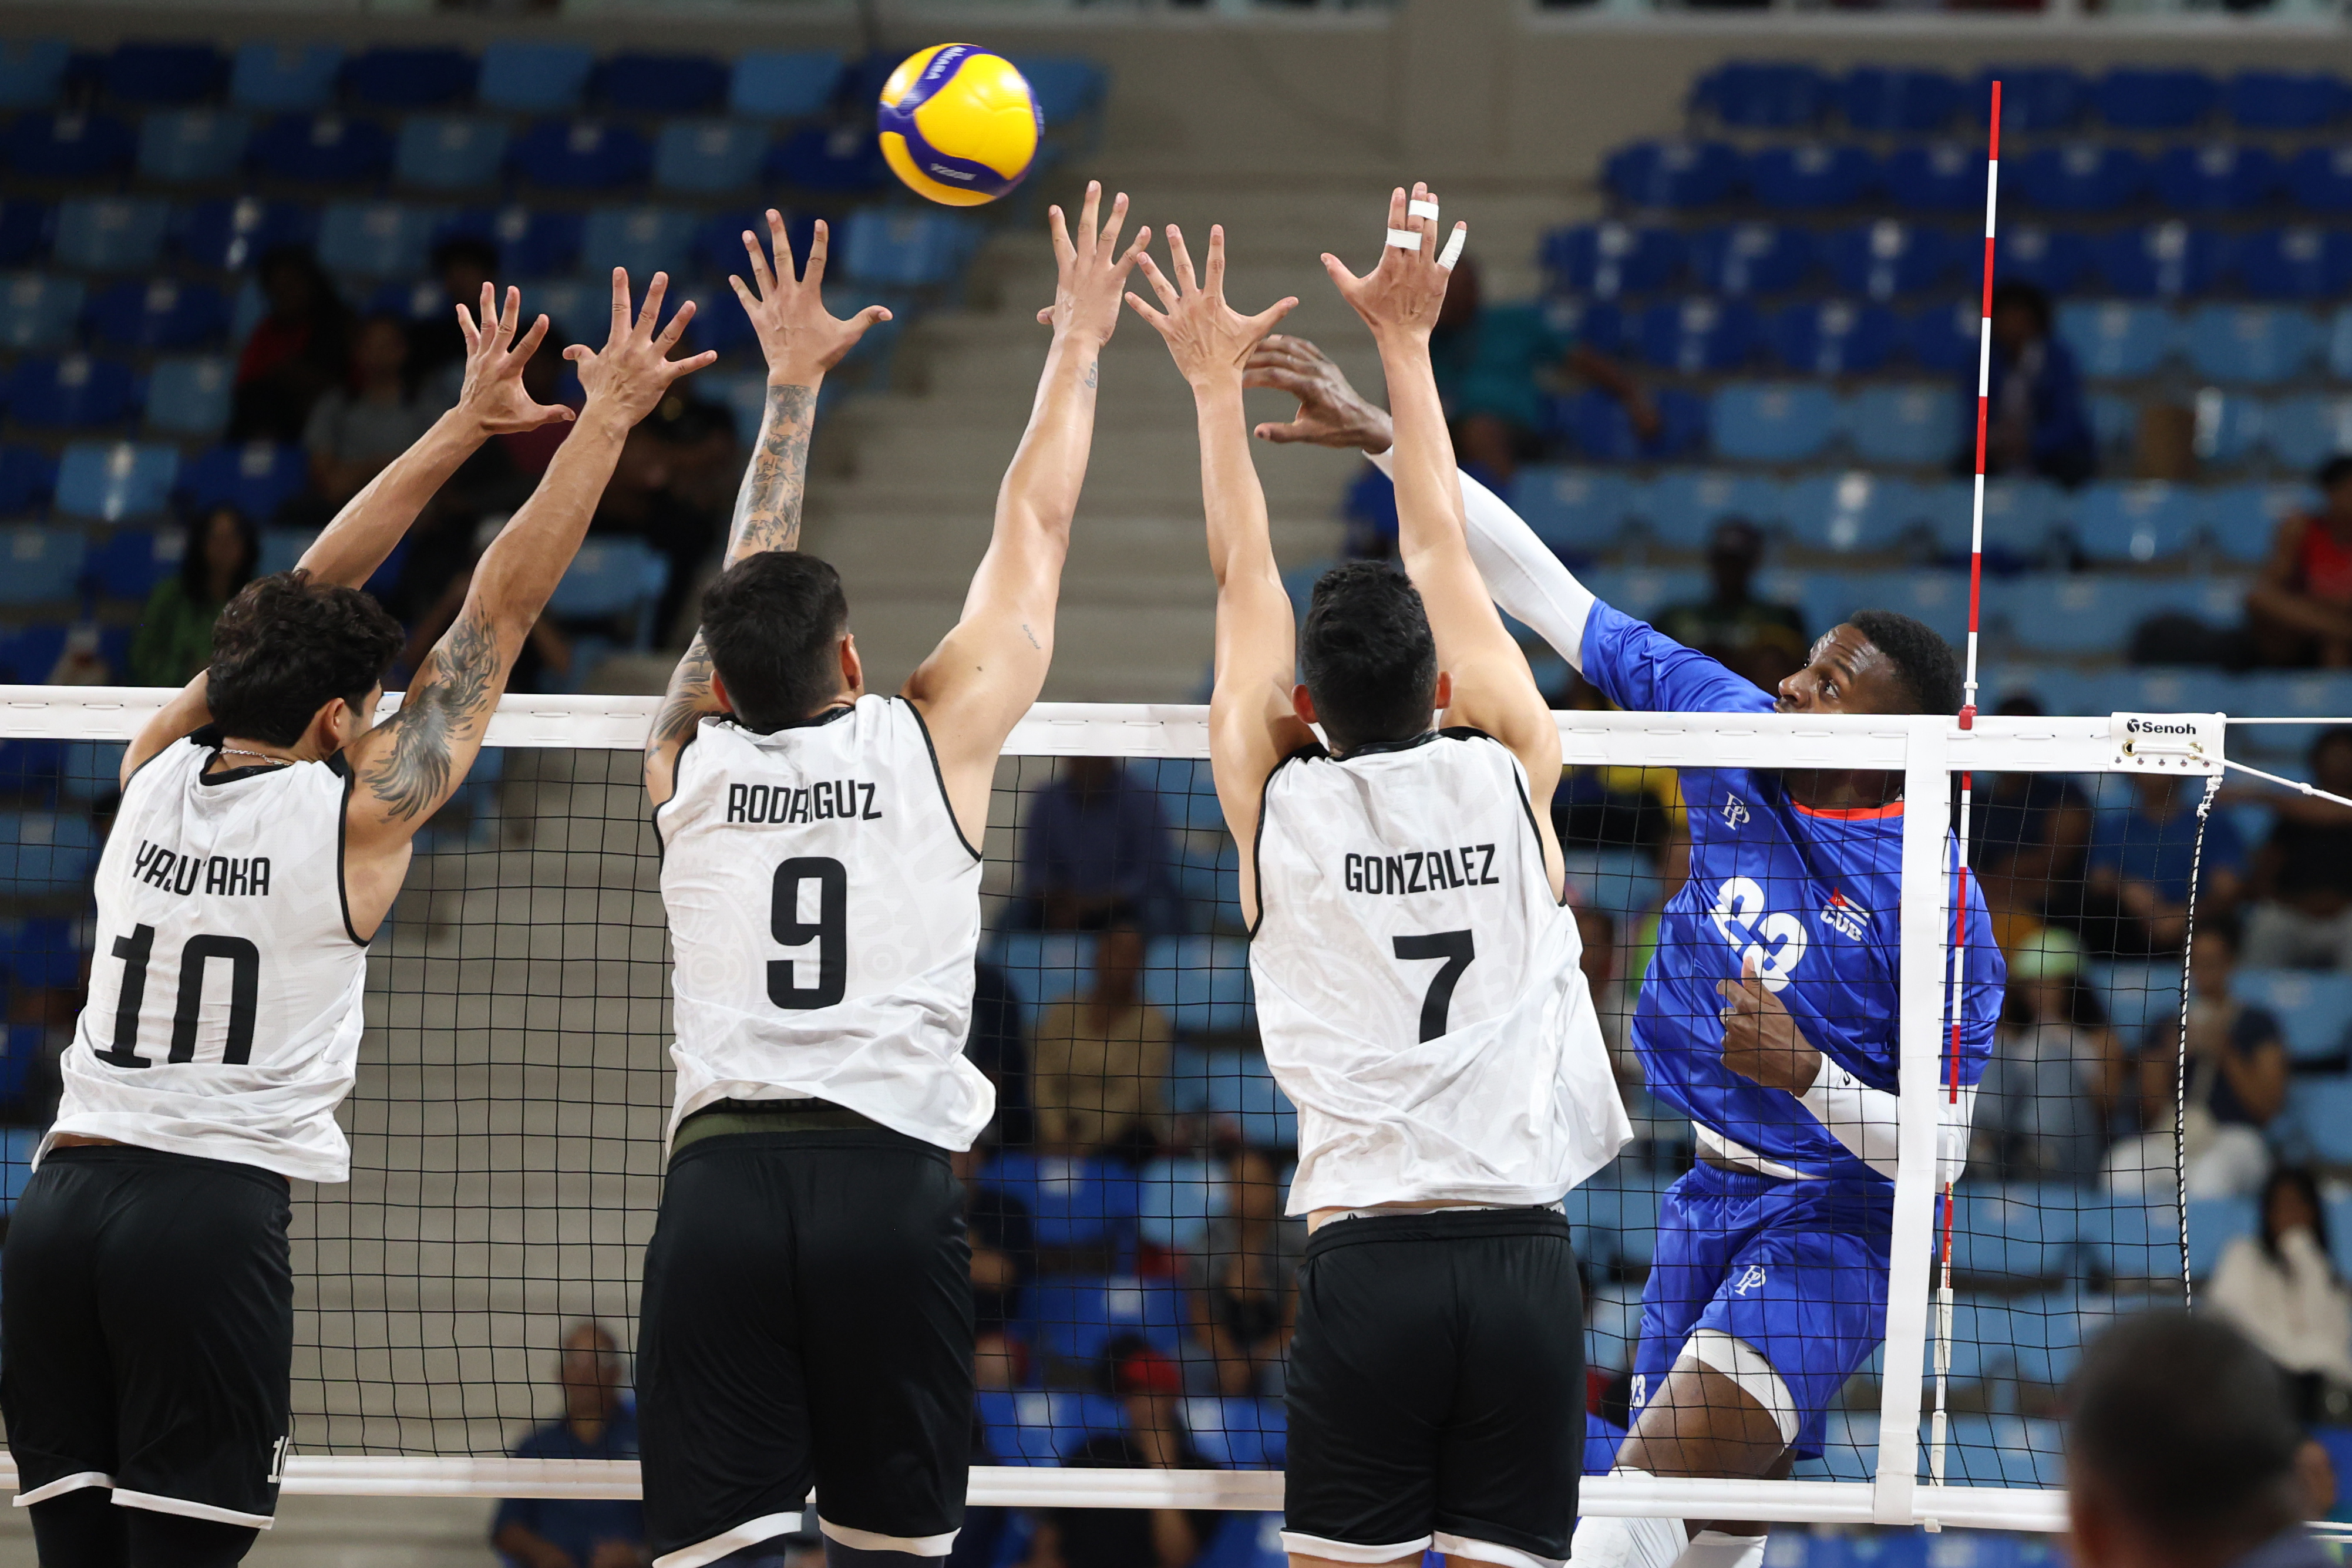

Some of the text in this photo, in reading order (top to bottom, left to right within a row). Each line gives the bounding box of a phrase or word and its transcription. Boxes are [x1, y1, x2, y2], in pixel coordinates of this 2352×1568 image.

[2142, 721, 2196, 735] Senoh
[132, 839, 271, 897] YAUAKA
[1344, 843, 1500, 895] GONZALEZ
[766, 857, 847, 1010] 9
[1709, 874, 1808, 993] 23
[1820, 904, 1863, 942] CUB
[95, 922, 260, 1069] 10
[1392, 928, 1475, 1045] 7
